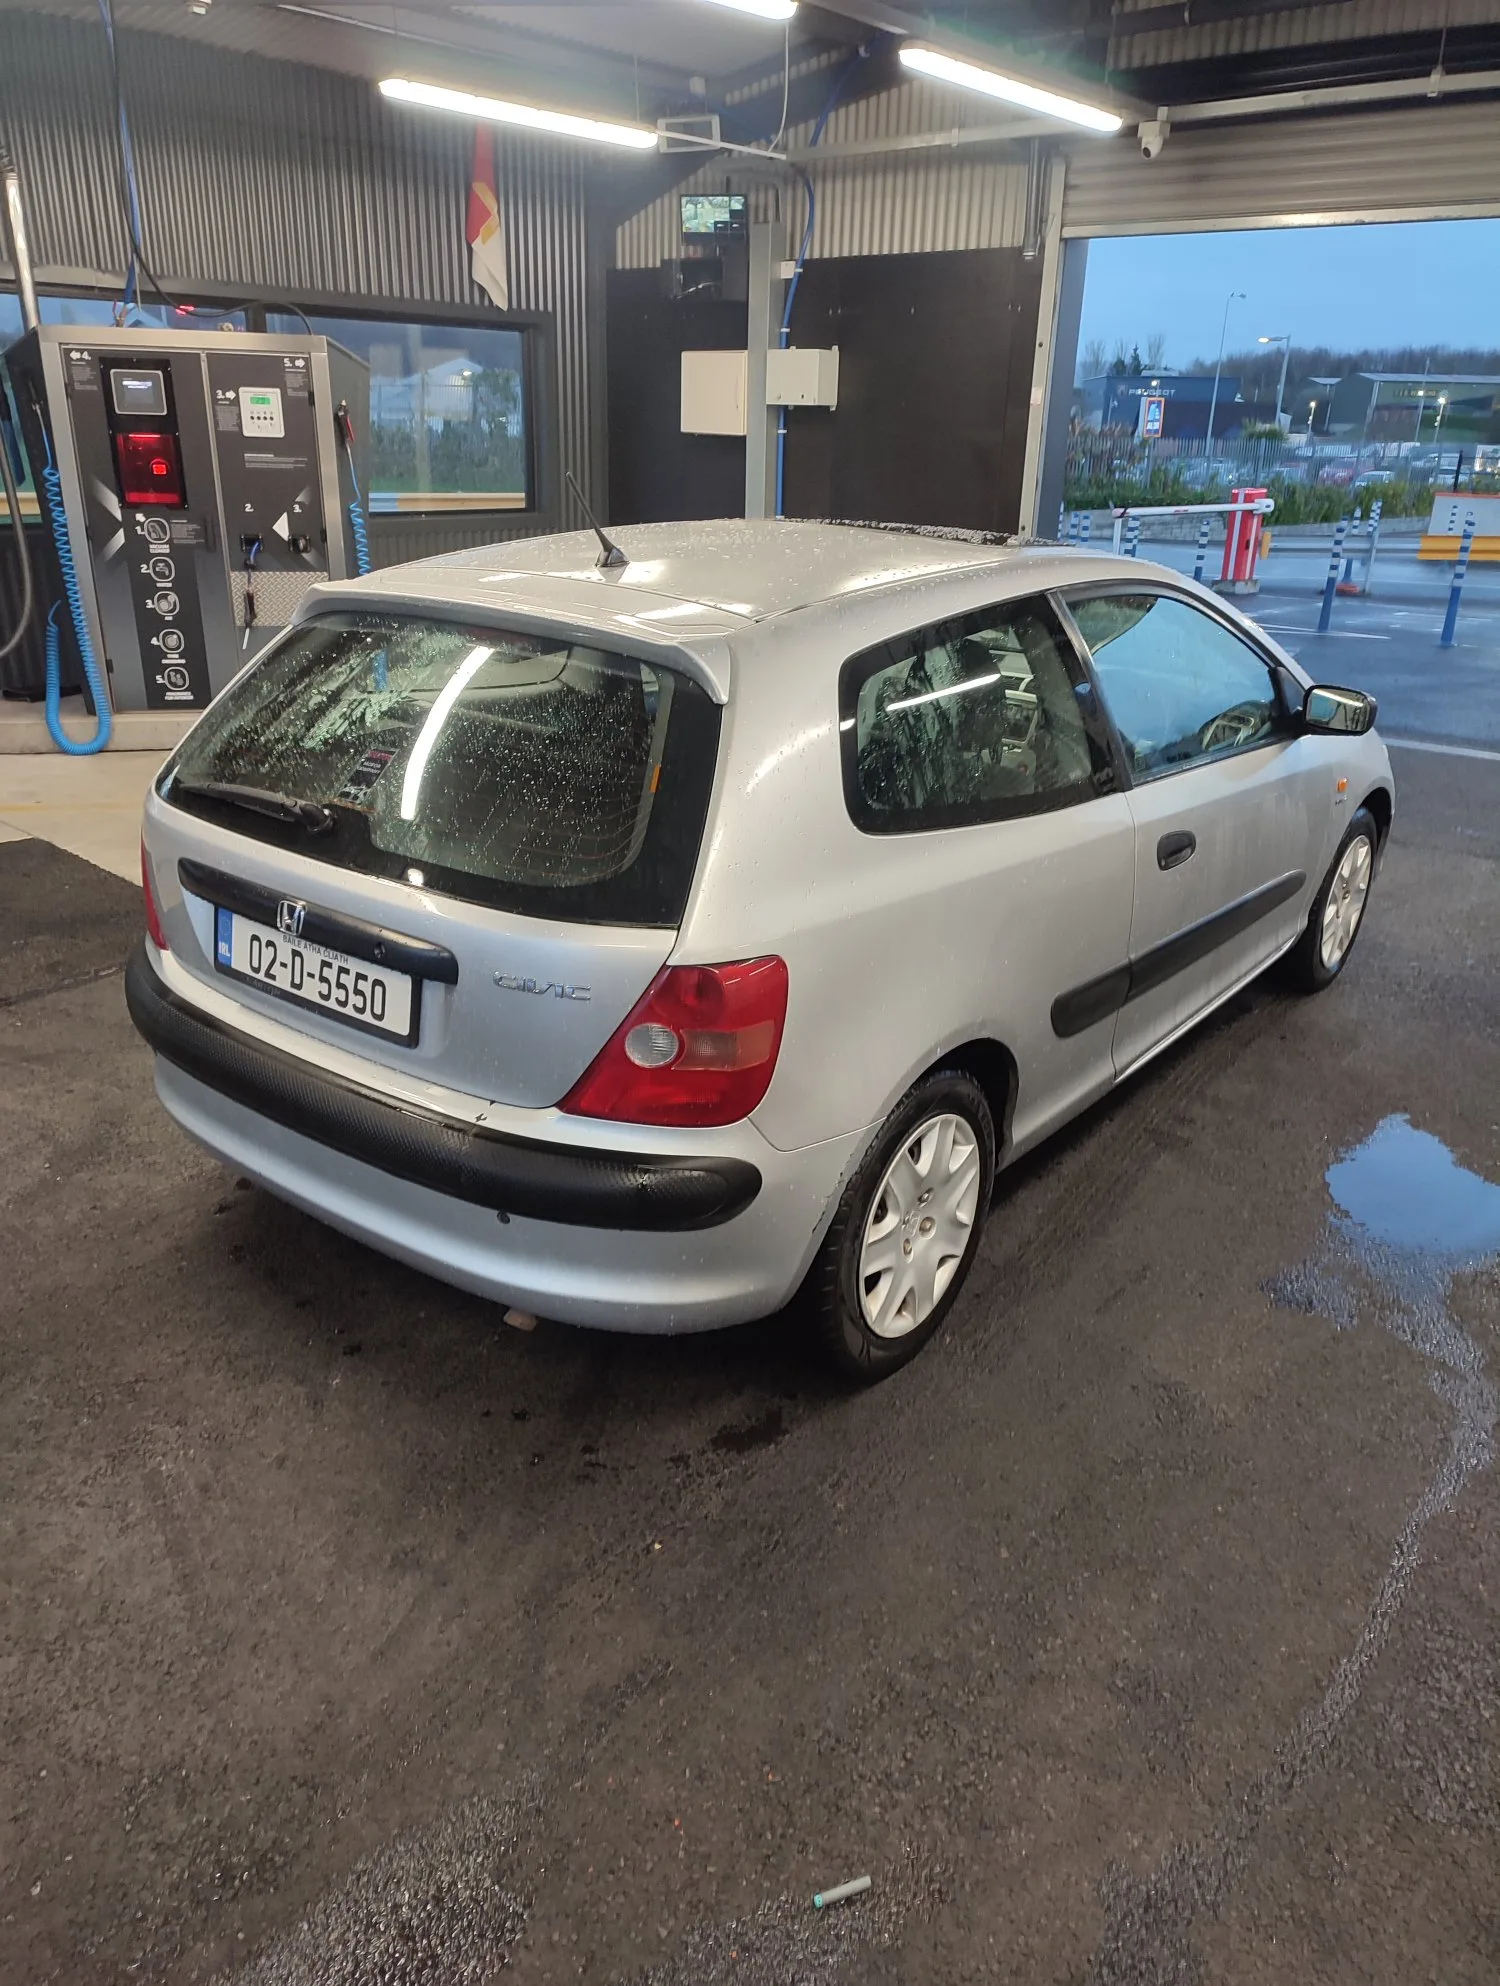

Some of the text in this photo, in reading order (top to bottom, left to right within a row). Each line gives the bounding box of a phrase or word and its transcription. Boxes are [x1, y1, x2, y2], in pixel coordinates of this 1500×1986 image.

[218, 940, 231, 958] IRL
[282, 934, 302, 949] BAILE
[323, 948, 349, 965] CLIATH
[249, 933, 387, 1023] 02-D-5550
[493, 970, 592, 1001] CIVIC
